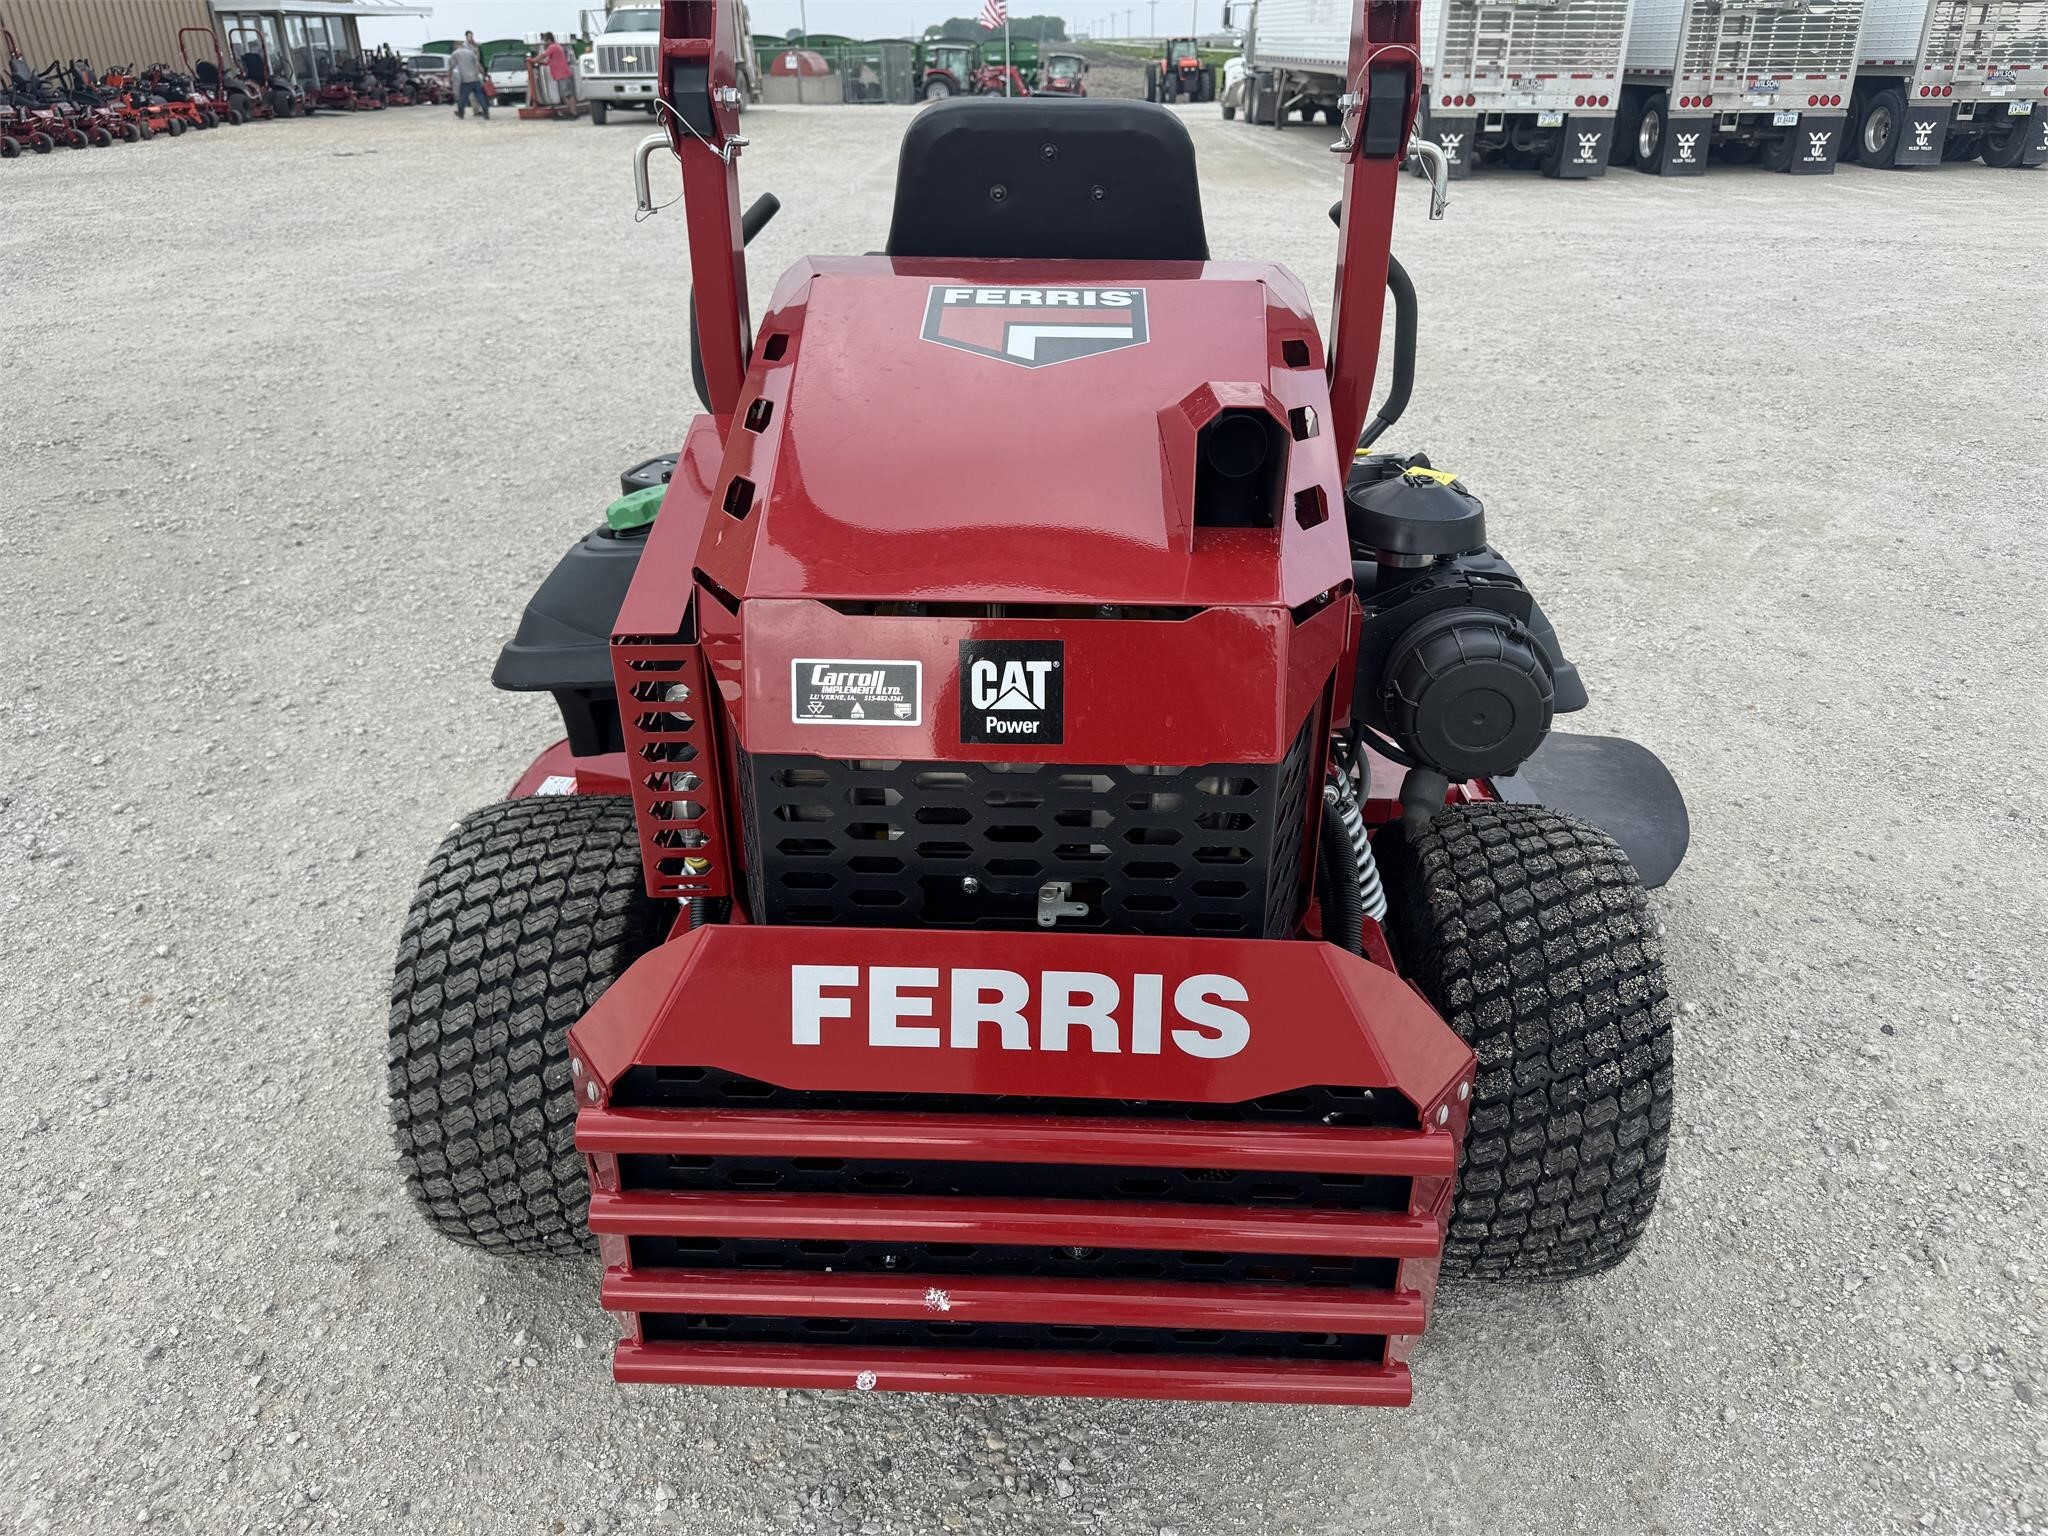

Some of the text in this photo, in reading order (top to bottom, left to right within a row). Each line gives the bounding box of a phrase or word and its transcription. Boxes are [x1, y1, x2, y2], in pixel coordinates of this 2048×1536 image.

[1518, 78, 1544, 87] WILSON
[1993, 69, 2018, 78] WILSON
[1754, 79, 1780, 88] WILSON
[943, 288, 1133, 306] FERRIS
[811, 664, 886, 695] Carroll
[971, 660, 1052, 710] CAT
[821, 685, 876, 695] IMPLEMENT
[986, 716, 1040, 734] Power
[791, 964, 1251, 1059] FERRIS
